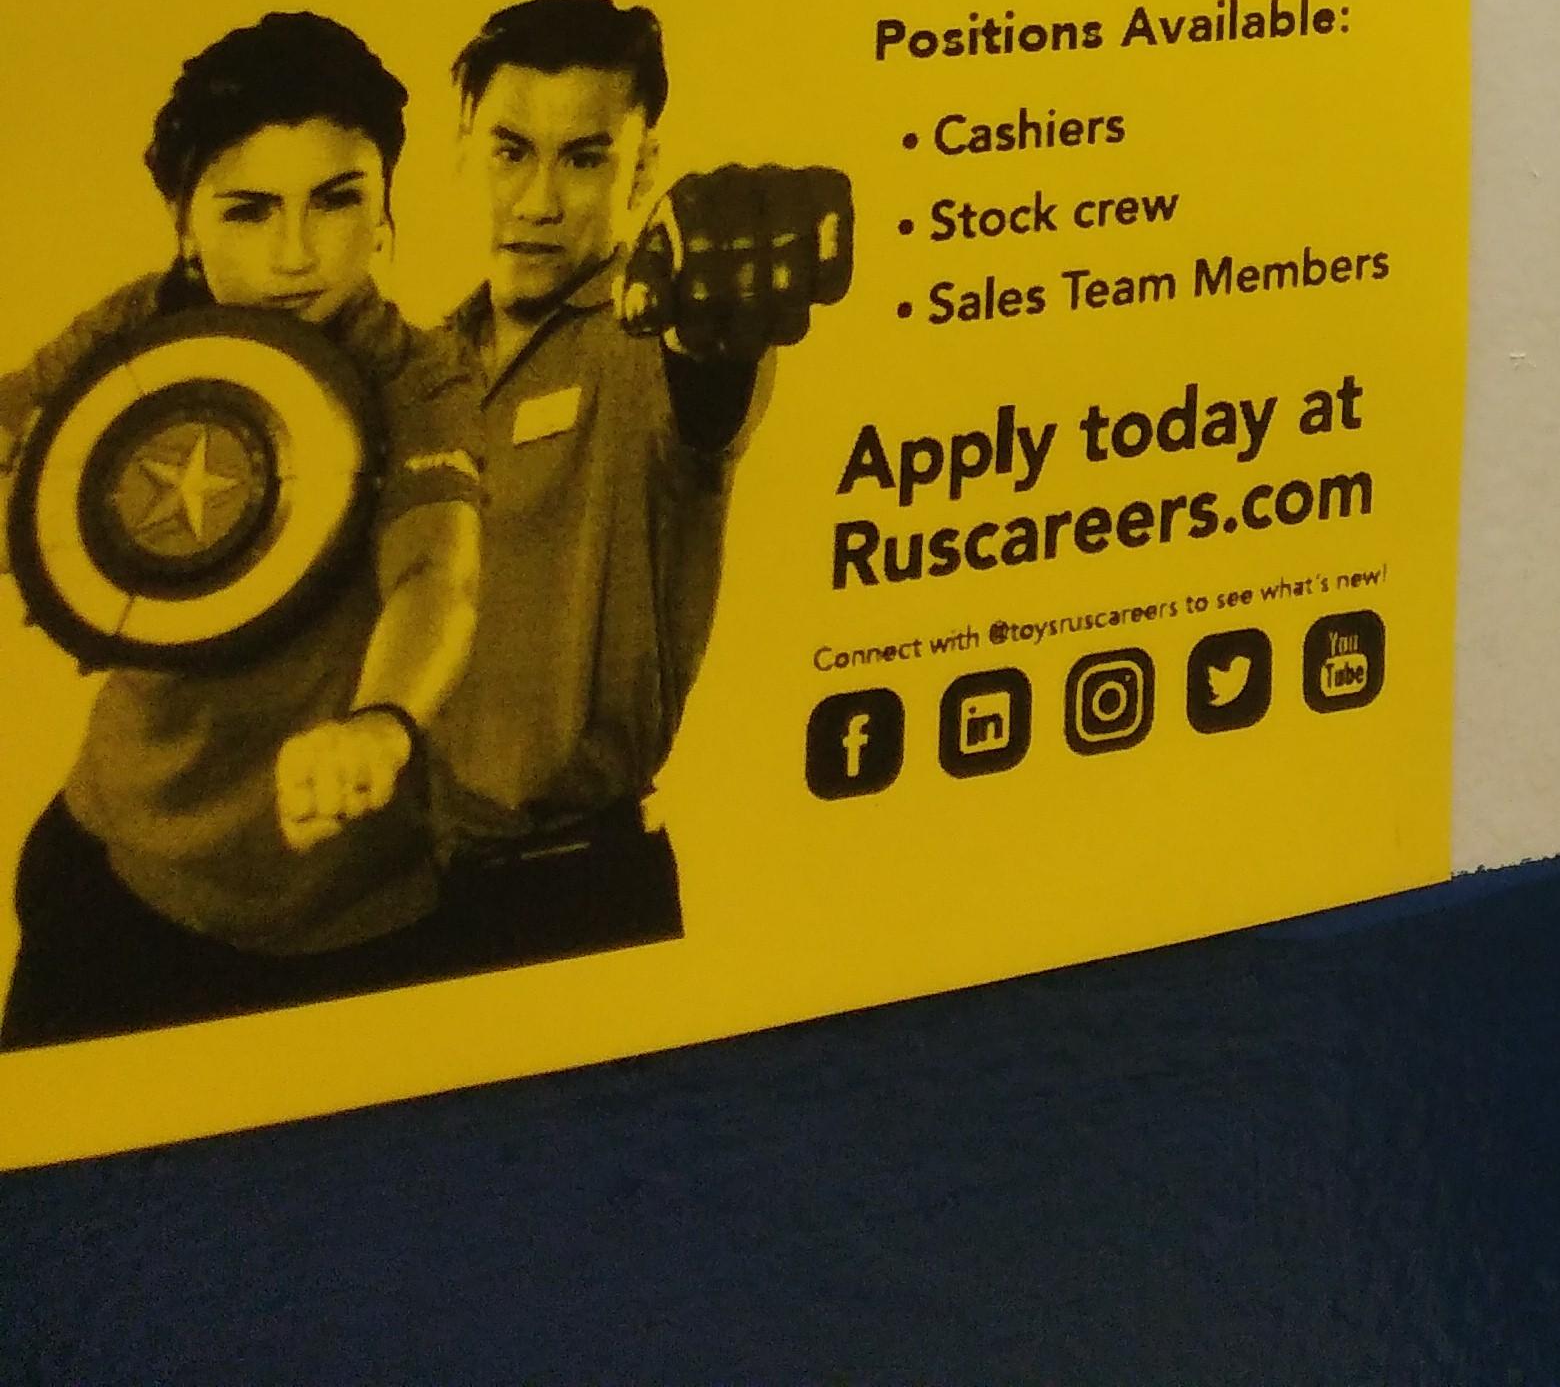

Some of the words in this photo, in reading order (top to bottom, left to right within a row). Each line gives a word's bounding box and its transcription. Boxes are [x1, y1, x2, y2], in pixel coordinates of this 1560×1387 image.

[875, 10, 1103, 61] Positions
[934, 107, 1126, 156] Cashiers
[930, 190, 1058, 242] Stock
[1073, 193, 1179, 229] crew
[928, 275, 1046, 325] Sales
[1061, 269, 1176, 312] Team
[1194, 246, 1390, 297] Members
[836, 405, 1057, 507] Apply
[1082, 383, 1277, 462] today
[1299, 374, 1364, 431] at
[832, 468, 1373, 590] Ruscareers.com
[813, 636, 922, 673] Connect
[929, 622, 980, 652] with
[988, 598, 1178, 646] @toysruscareers
[1184, 591, 1209, 614] to
[1216, 586, 1254, 609] see
[1260, 572, 1330, 603] what's
[1336, 563, 1389, 590] new!
[1327, 629, 1359, 655] You
[1324, 660, 1366, 690] Tube
